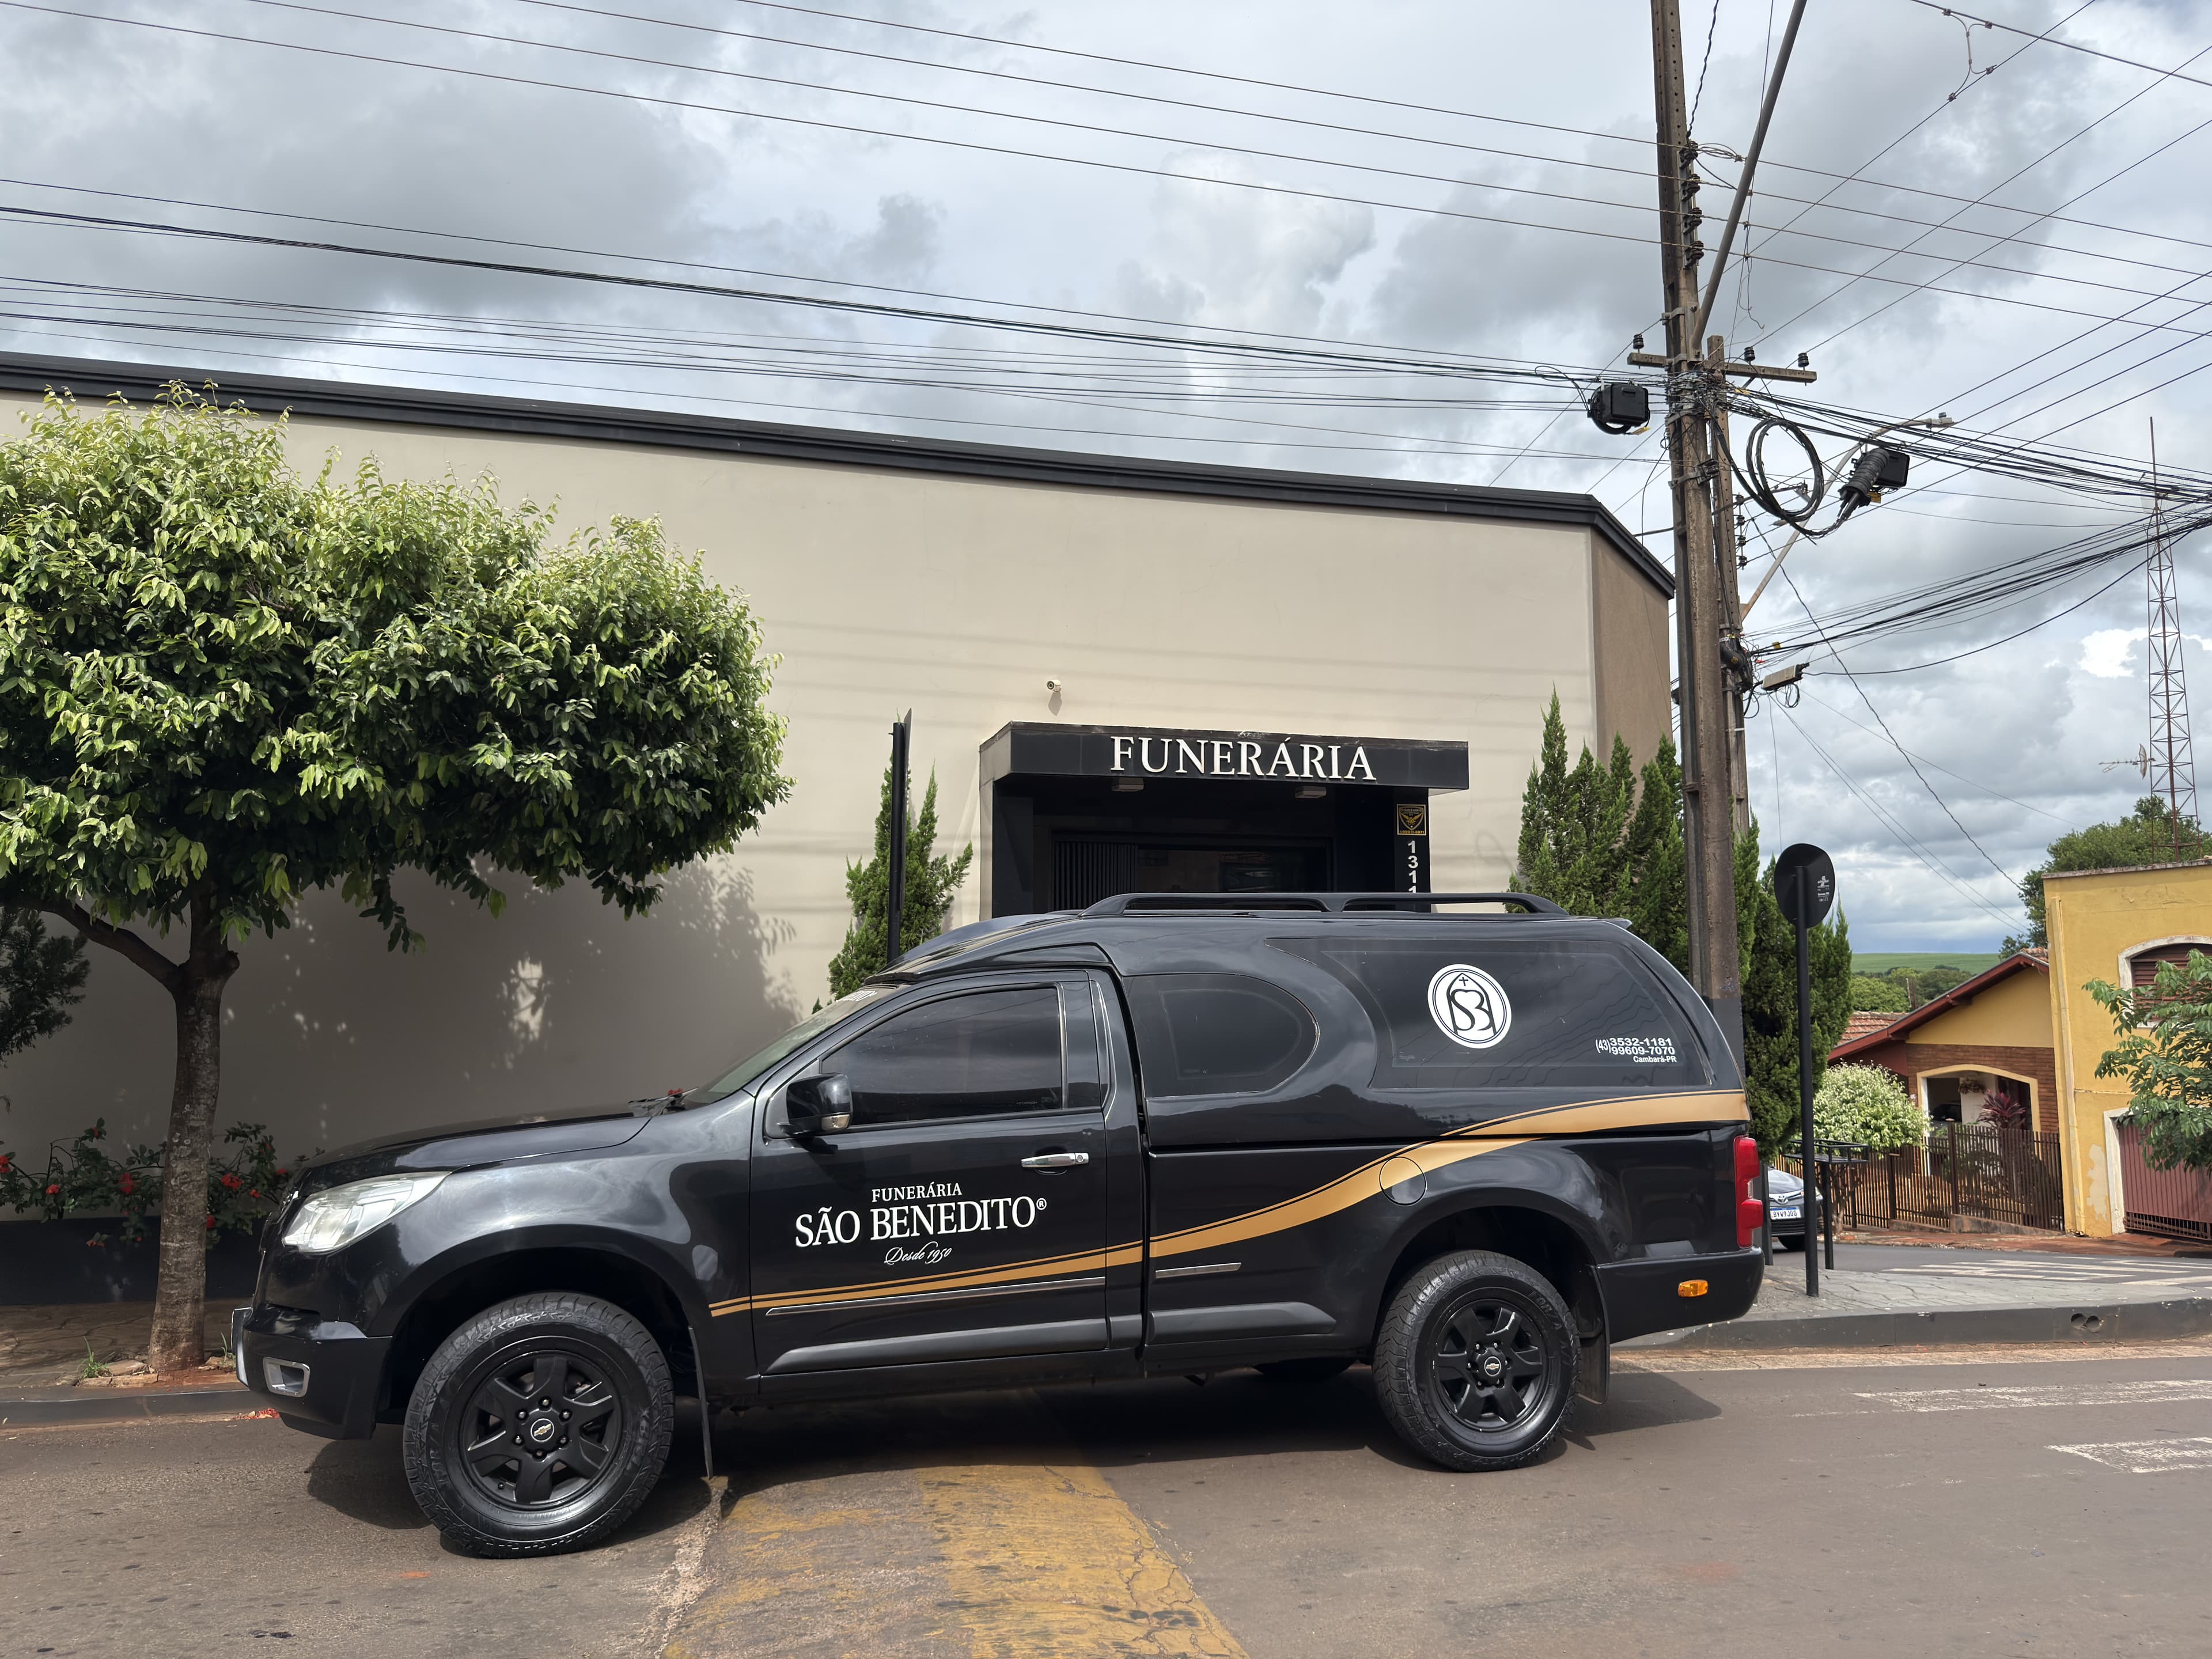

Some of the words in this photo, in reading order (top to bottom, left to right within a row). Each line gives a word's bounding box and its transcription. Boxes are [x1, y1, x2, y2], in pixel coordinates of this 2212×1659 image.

[1110, 736, 1377, 781] FUNERÁRIA
[1595, 1039, 1611, 1054] (43)
[1609, 1037, 1672, 1047] 3532-1181
[1611, 1046, 1676, 1055] 99609-7070
[872, 1181, 963, 1203] FUNERÁRIA
[796, 1206, 861, 1248] SÃO
[884, 1241, 938, 1265] Desde
[925, 1248, 952, 1264] 1950
